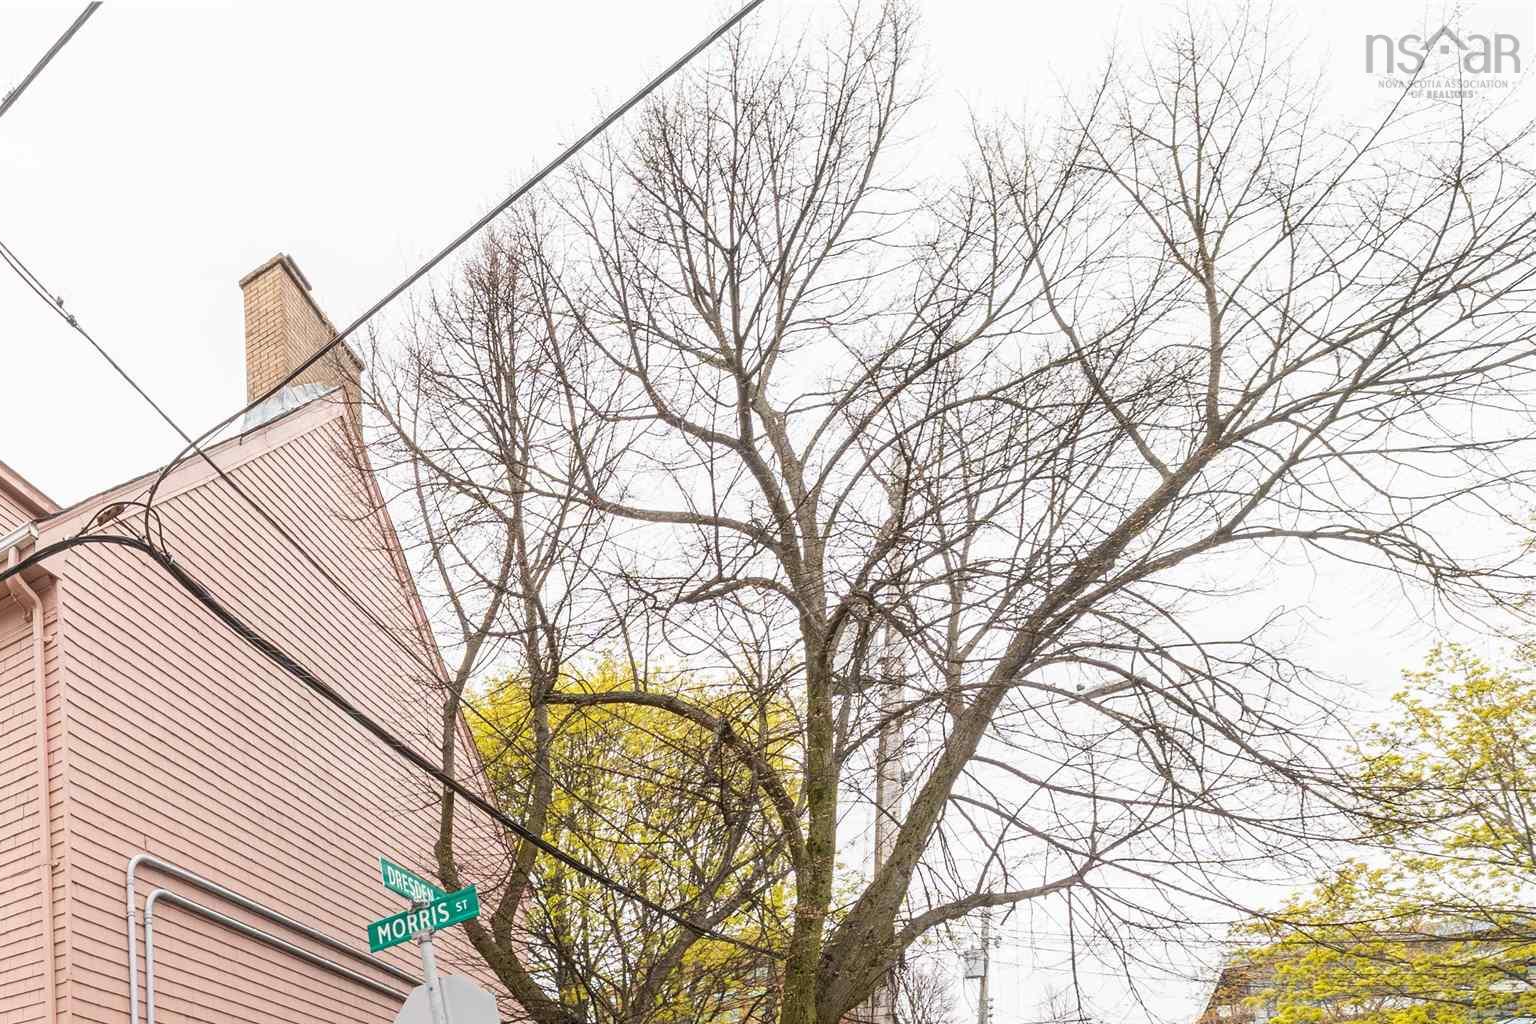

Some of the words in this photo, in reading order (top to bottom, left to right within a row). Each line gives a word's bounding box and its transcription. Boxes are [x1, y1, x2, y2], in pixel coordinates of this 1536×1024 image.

[387, 866, 435, 902] DRESDEN
[377, 902, 450, 944] MORRIS
[455, 899, 468, 912] ST
